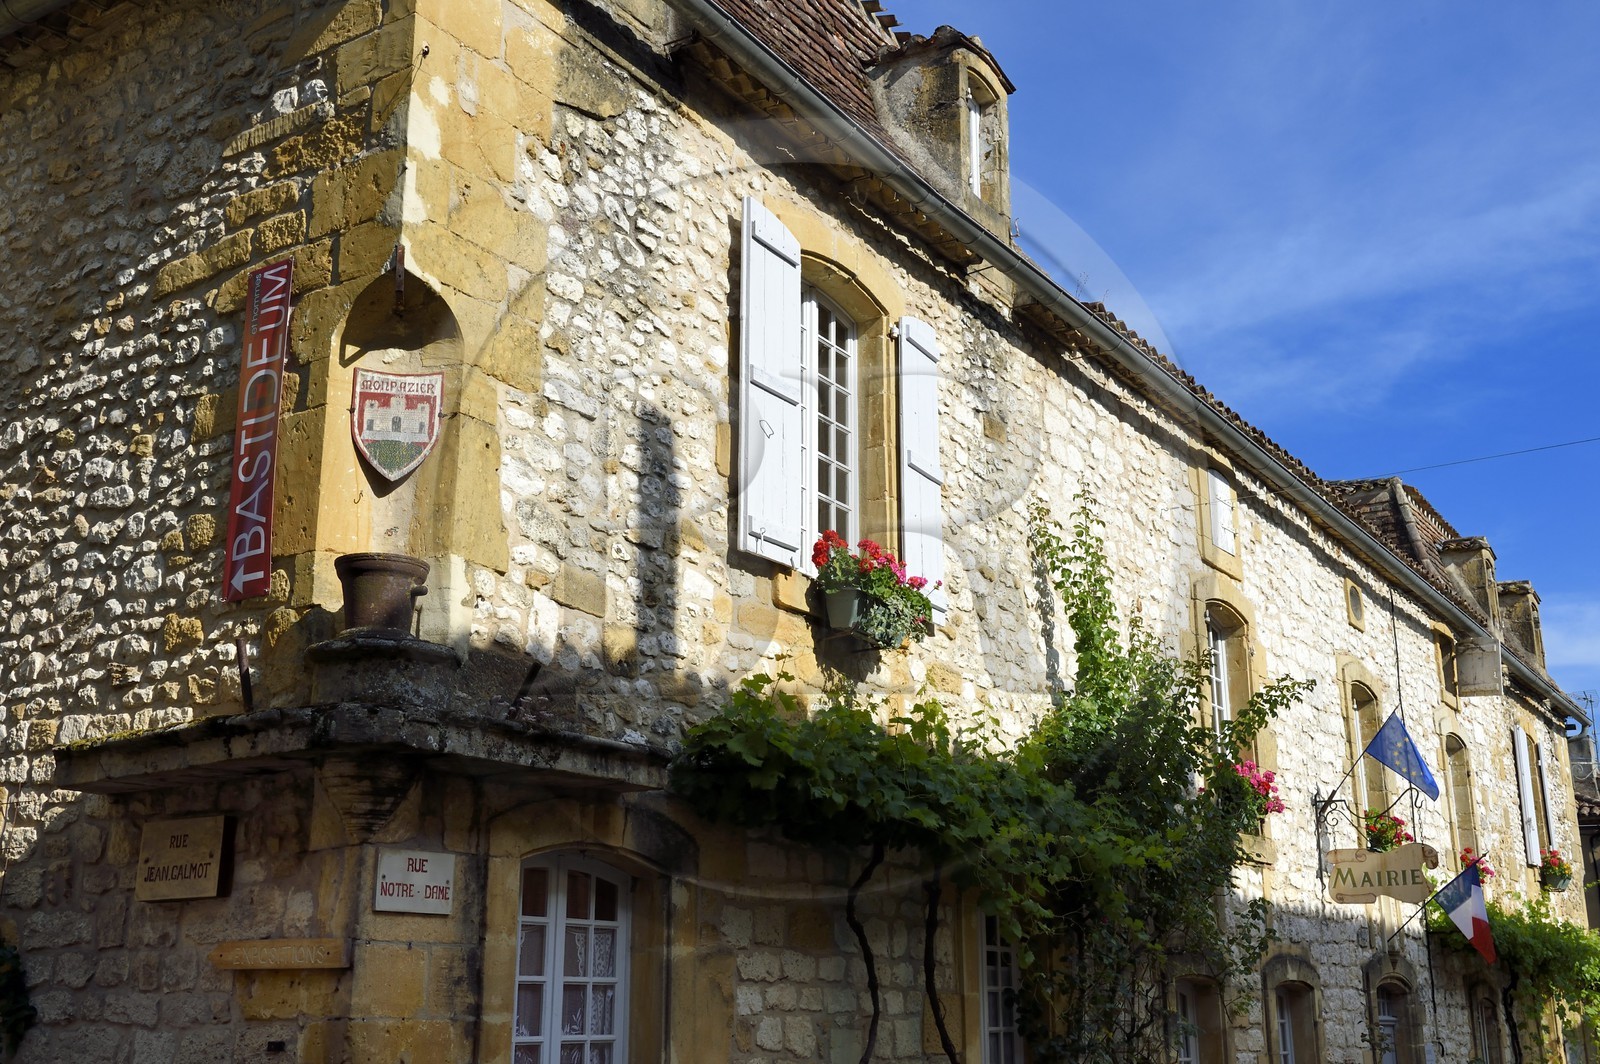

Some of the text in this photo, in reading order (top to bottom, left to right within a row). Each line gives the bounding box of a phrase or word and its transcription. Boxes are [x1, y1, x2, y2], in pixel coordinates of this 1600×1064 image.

[361, 379, 435, 394] MONPAZIER
[231, 263, 289, 562] BASTIDEUM
[169, 834, 189, 849] RUE
[407, 857, 428, 873] RUE
[1333, 867, 1423, 888] MAIRIE
[233, 945, 326, 965] EXPOSITIONS
